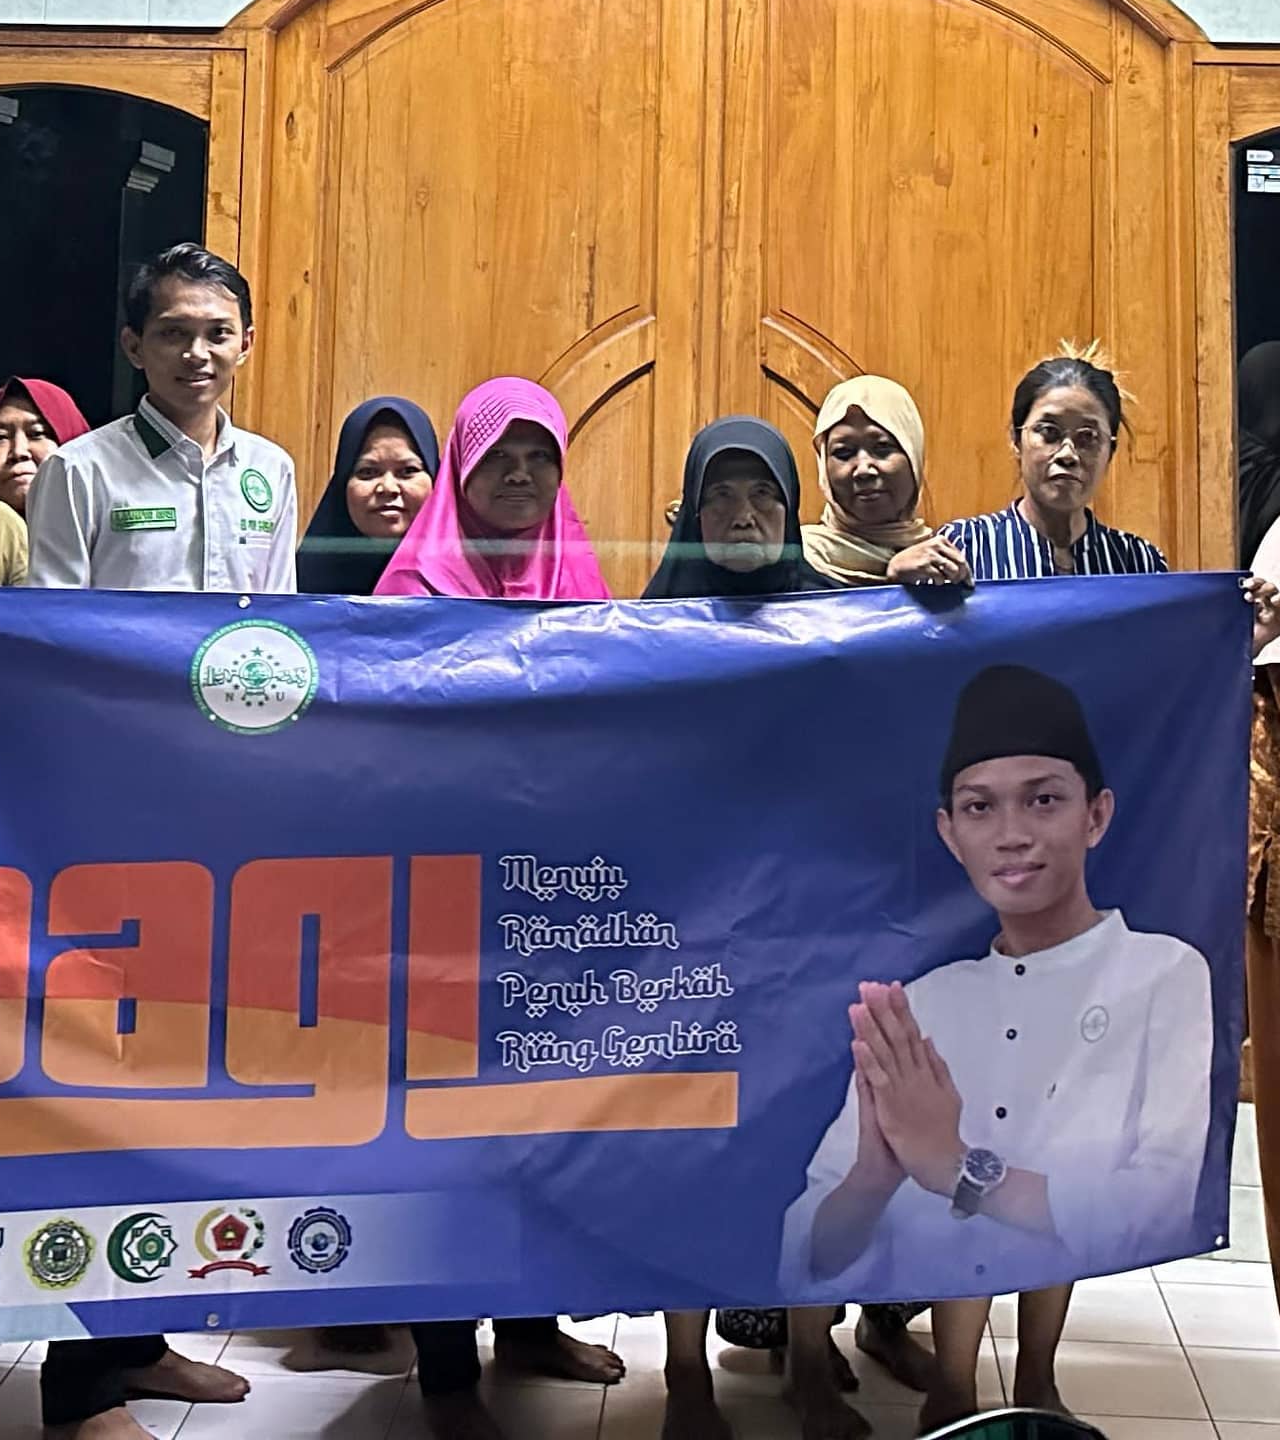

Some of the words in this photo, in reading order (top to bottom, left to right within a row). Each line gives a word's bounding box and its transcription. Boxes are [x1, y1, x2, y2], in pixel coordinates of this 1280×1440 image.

[498, 855, 628, 902] Menuju
[496, 969, 609, 1018] Penuh
[496, 1030, 599, 1073] Riang
